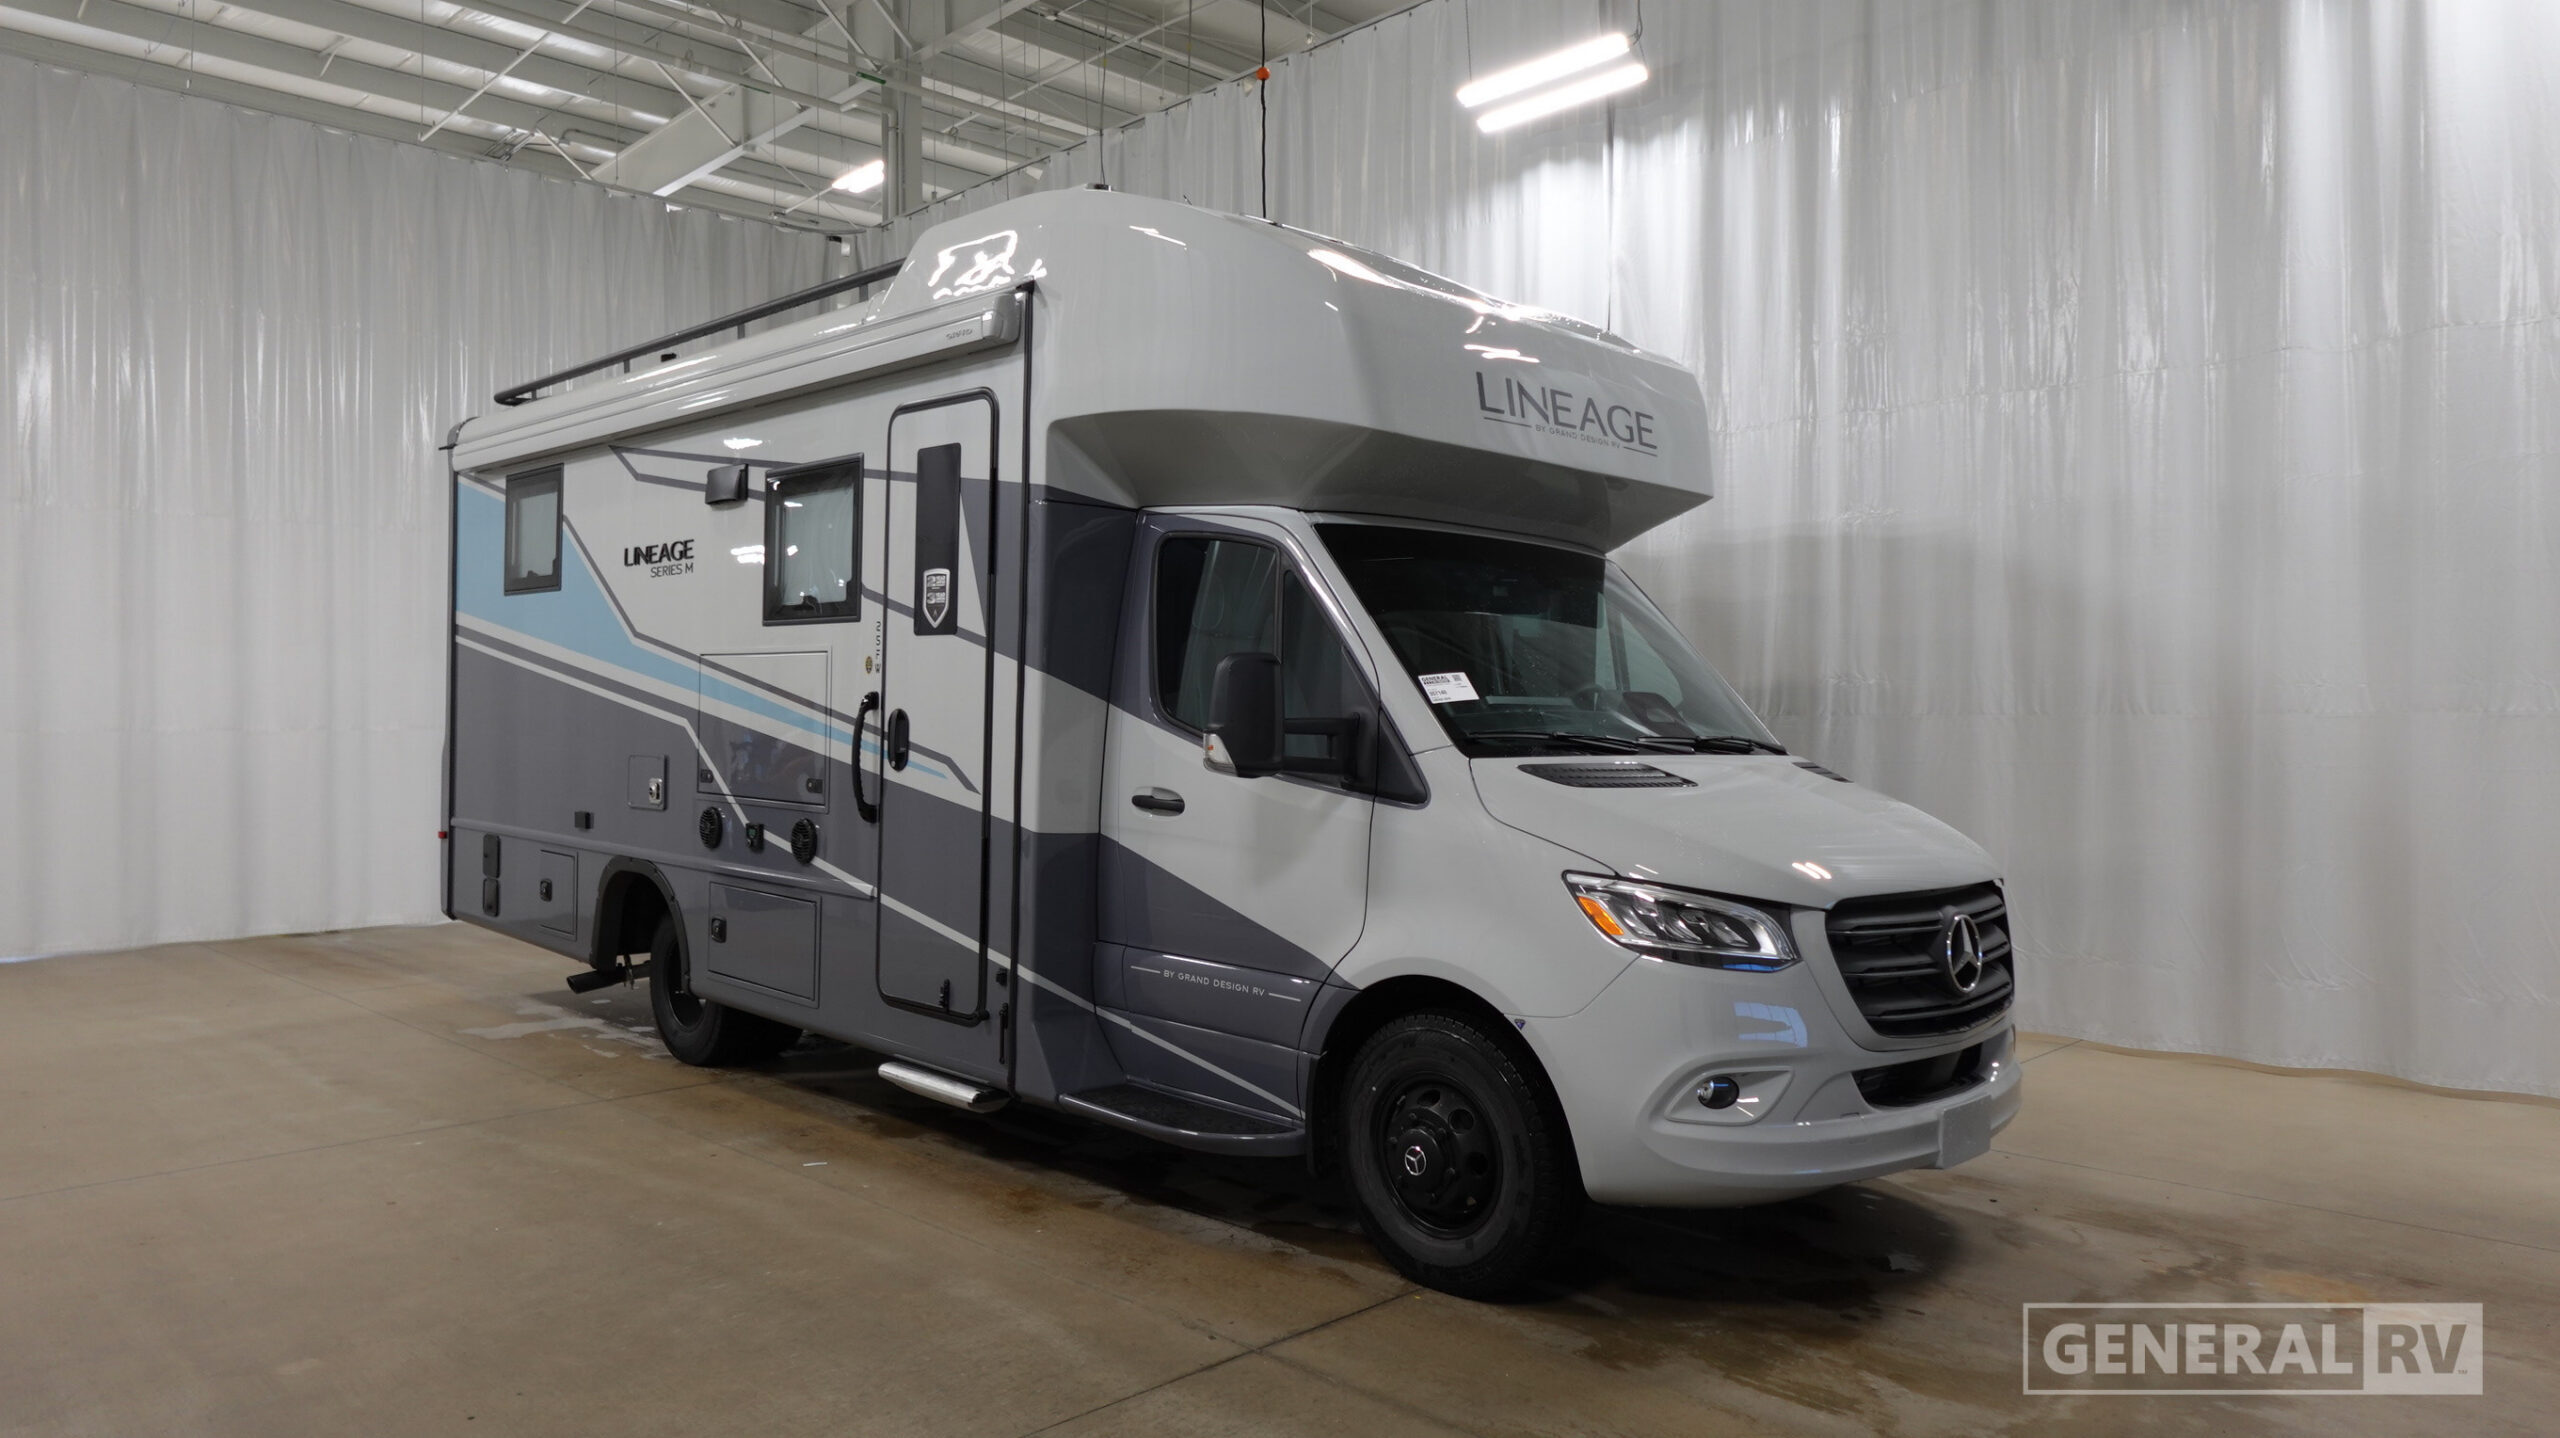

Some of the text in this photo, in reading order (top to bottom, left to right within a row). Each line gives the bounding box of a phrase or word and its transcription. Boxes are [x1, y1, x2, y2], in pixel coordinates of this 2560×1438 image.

[1476, 371, 1657, 449] LINEAGE
[1549, 427, 1577, 439] GRAND
[624, 539, 694, 567] LINEAGE
[650, 562, 694, 578] SERIES M
[1163, 969, 1265, 997] BY GRAND DESIGN RV
